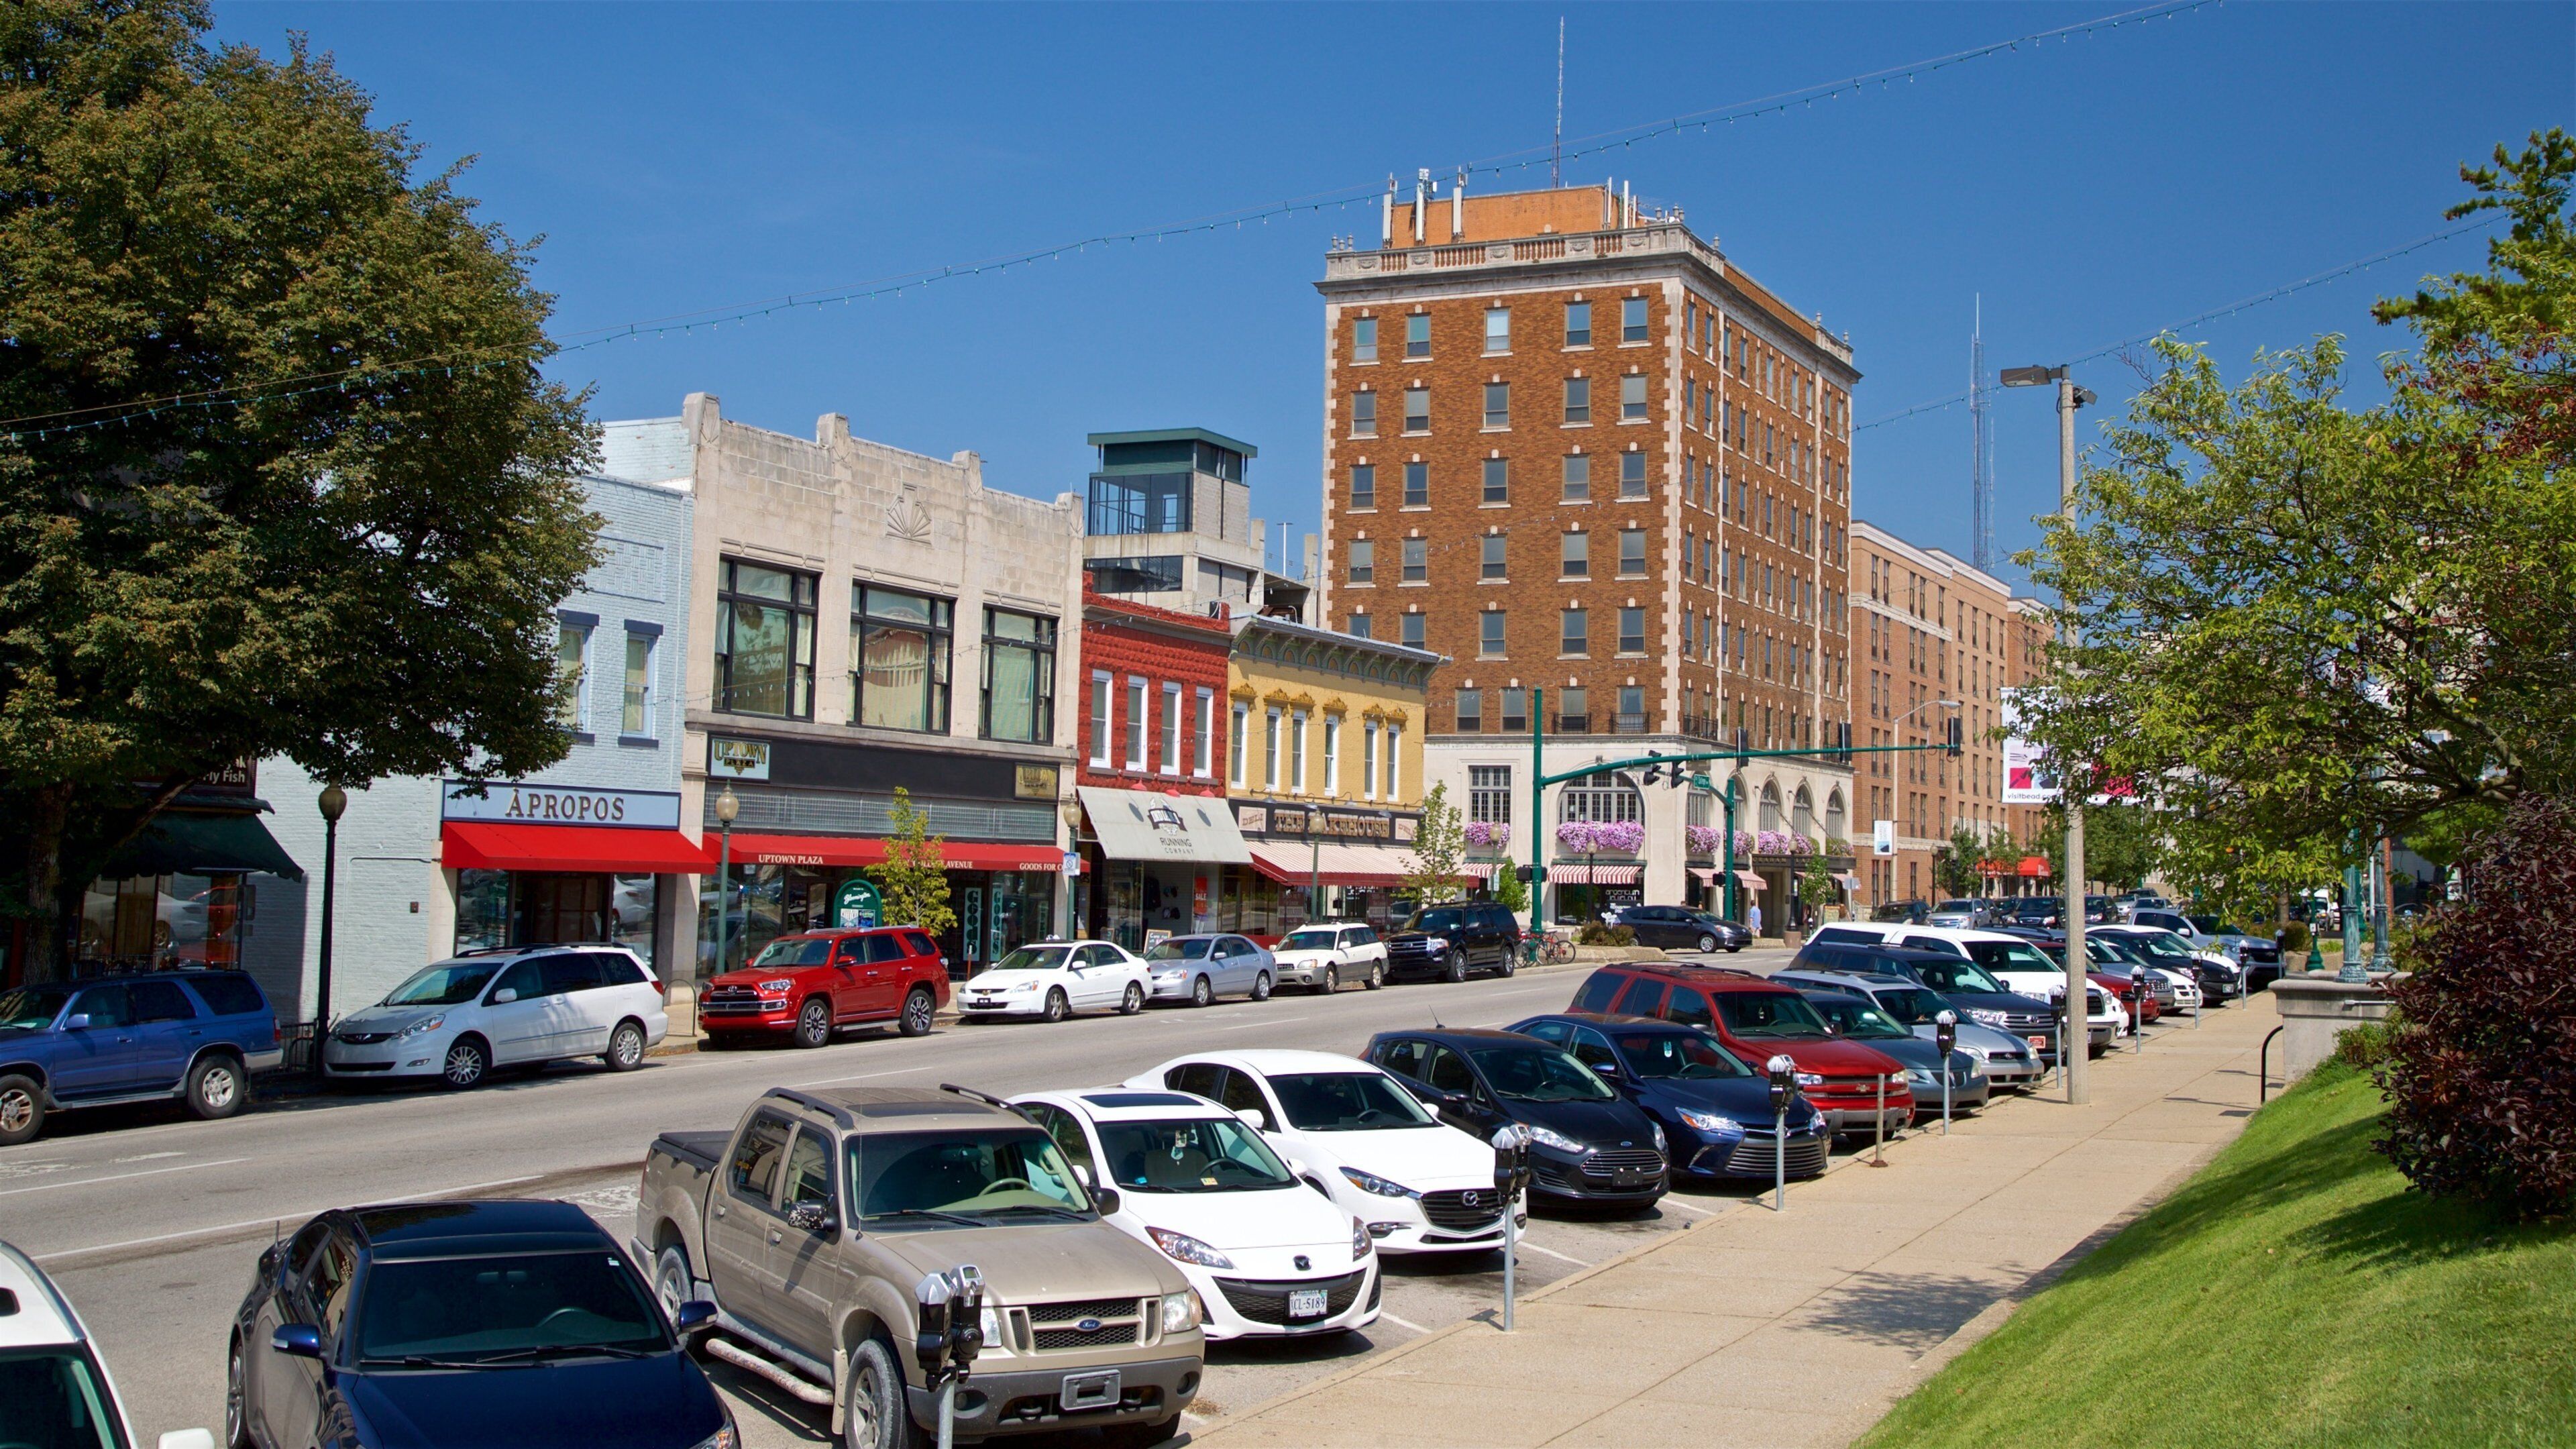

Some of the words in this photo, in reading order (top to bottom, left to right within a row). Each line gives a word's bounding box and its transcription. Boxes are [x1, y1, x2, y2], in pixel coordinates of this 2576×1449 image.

[714, 740, 768, 764] UPTOWN
[223, 770, 246, 783] Fish
[1275, 809, 1305, 834] THE
[1308, 812, 1390, 839] AKEHOUSE
[1160, 837, 1192, 847] RUNNING
[759, 854, 796, 864] UPTOWN
[798, 855, 824, 865] PLAZA
[946, 860, 973, 869] AVENUE
[1020, 862, 1042, 871] GOODS
[1044, 863, 1056, 871] FOR
